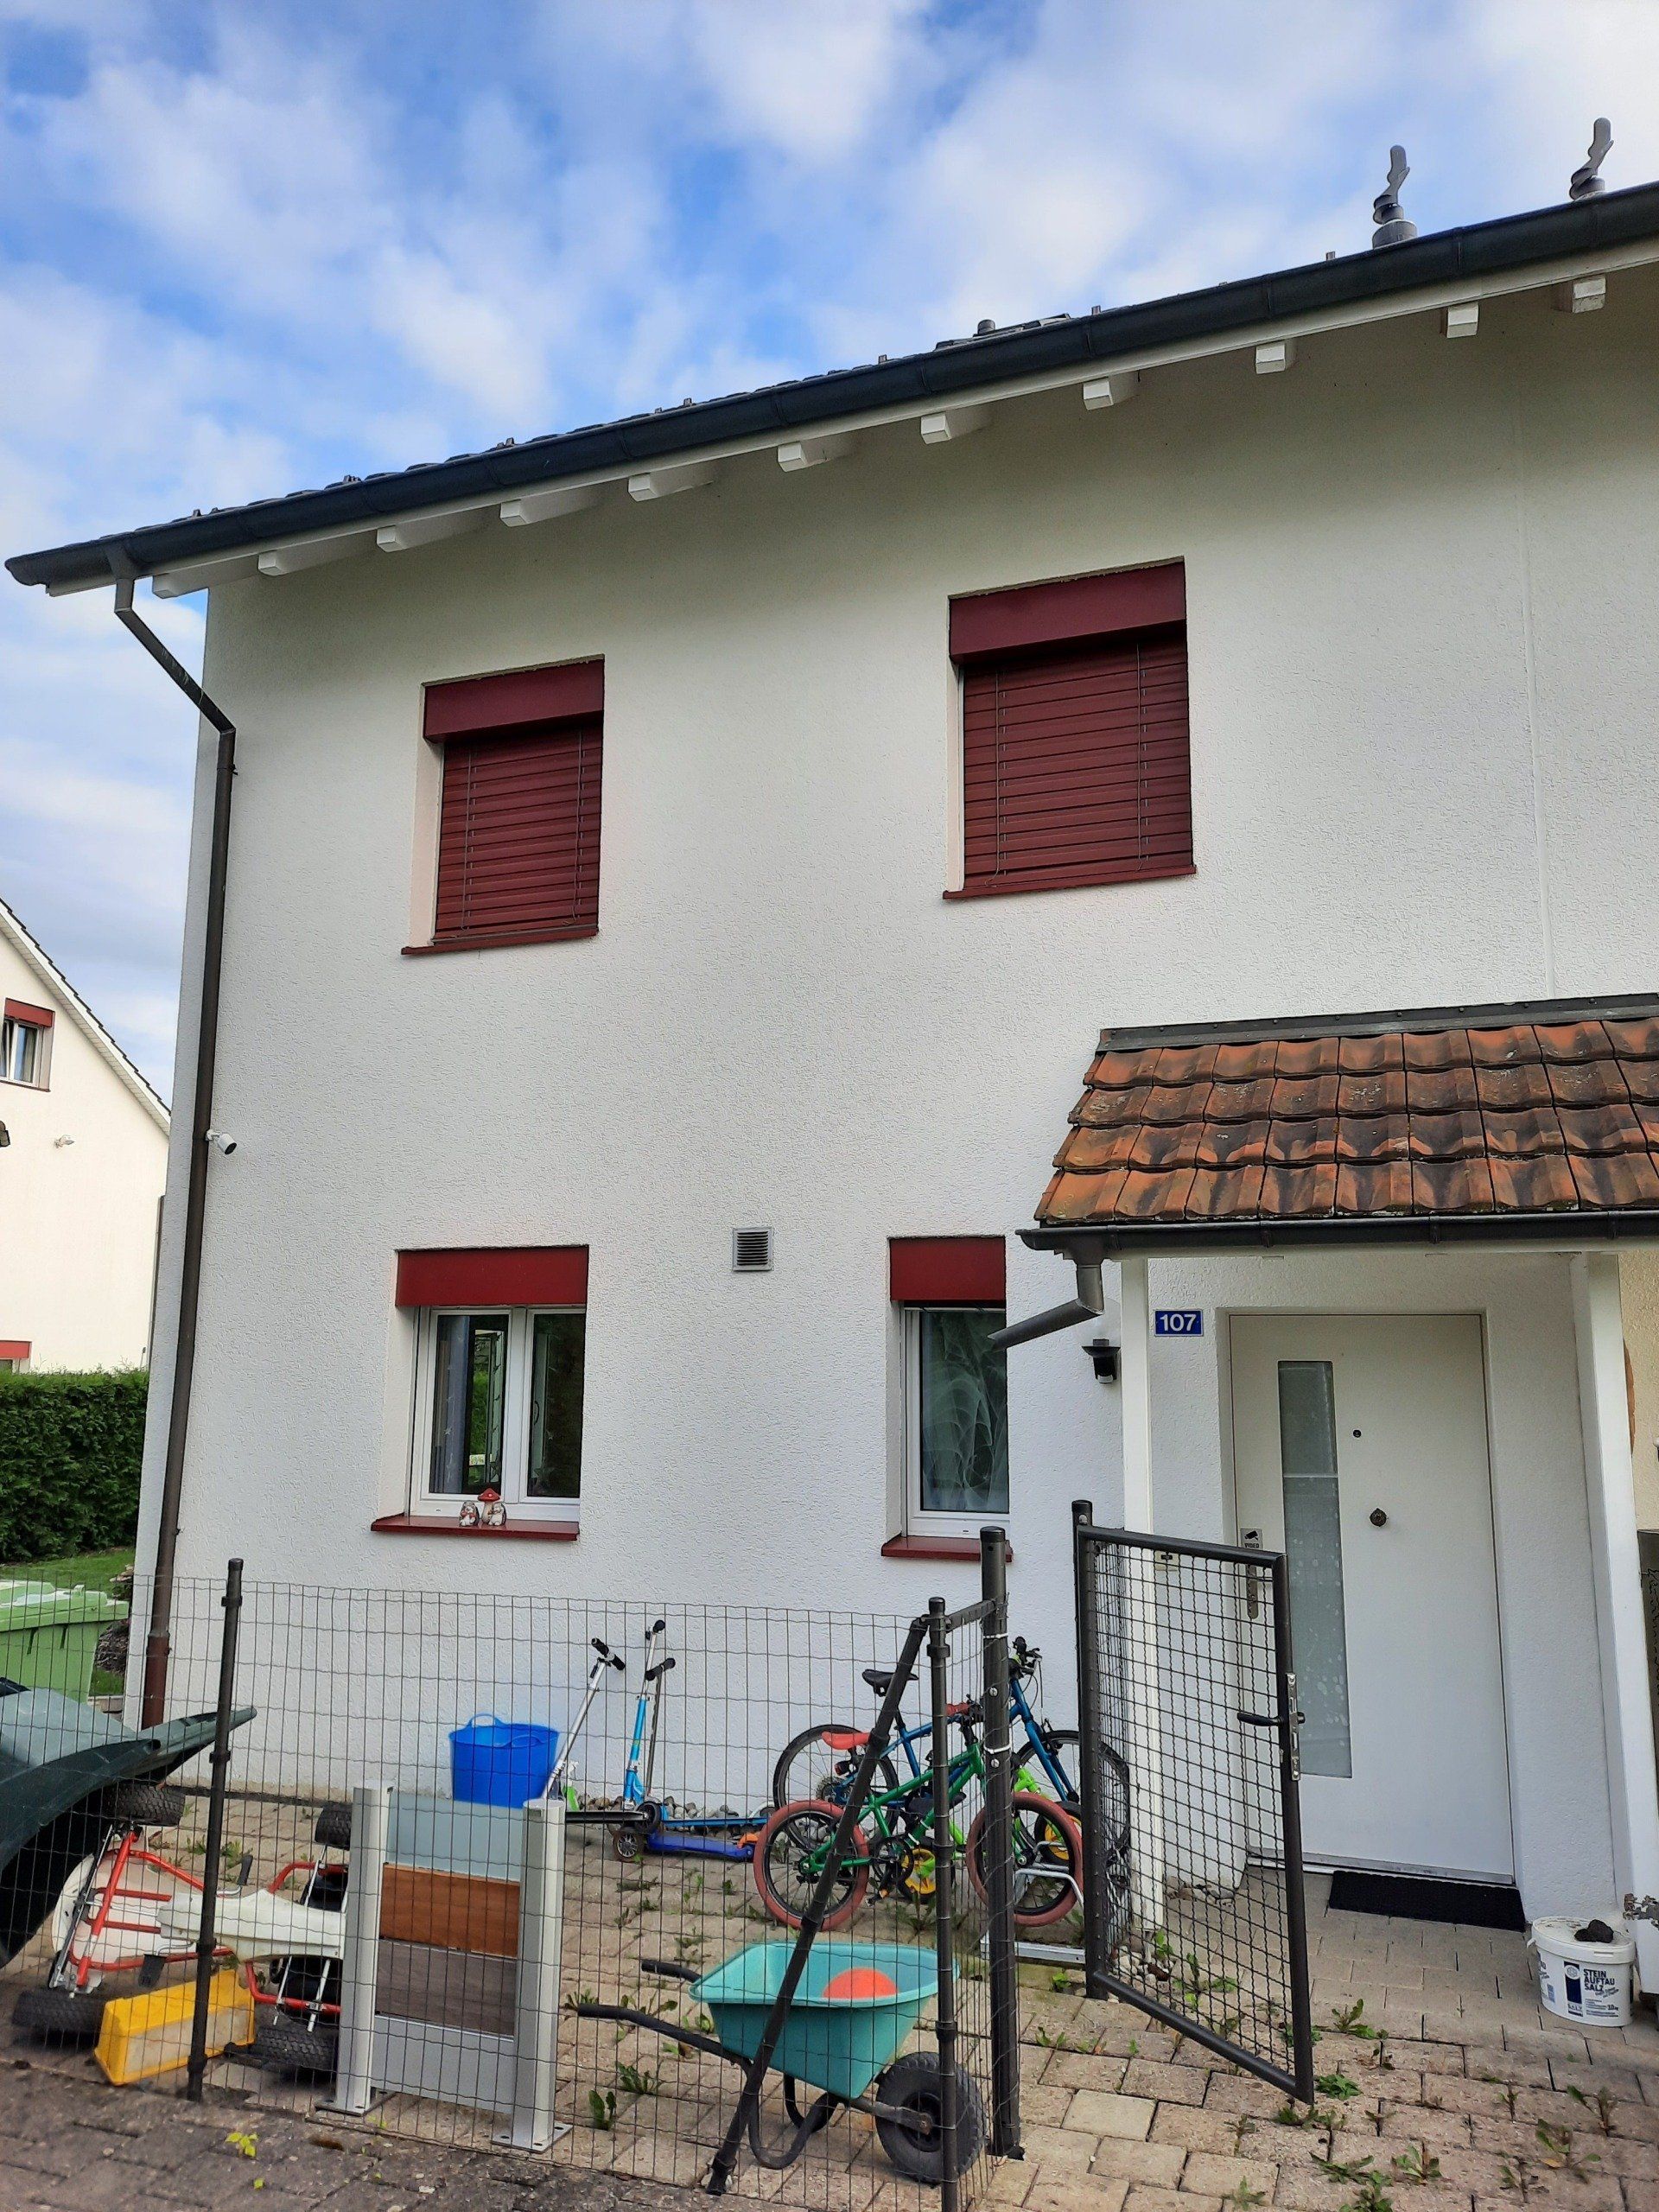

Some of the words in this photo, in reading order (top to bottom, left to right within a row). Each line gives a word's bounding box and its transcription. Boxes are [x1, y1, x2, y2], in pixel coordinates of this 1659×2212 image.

[1160, 1313, 1197, 1332] 107
[1583, 1968, 1606, 1977] STEIN
[1584, 1977, 1615, 1986] AUFTAU
[1584, 1983, 1604, 1992] SALZ
